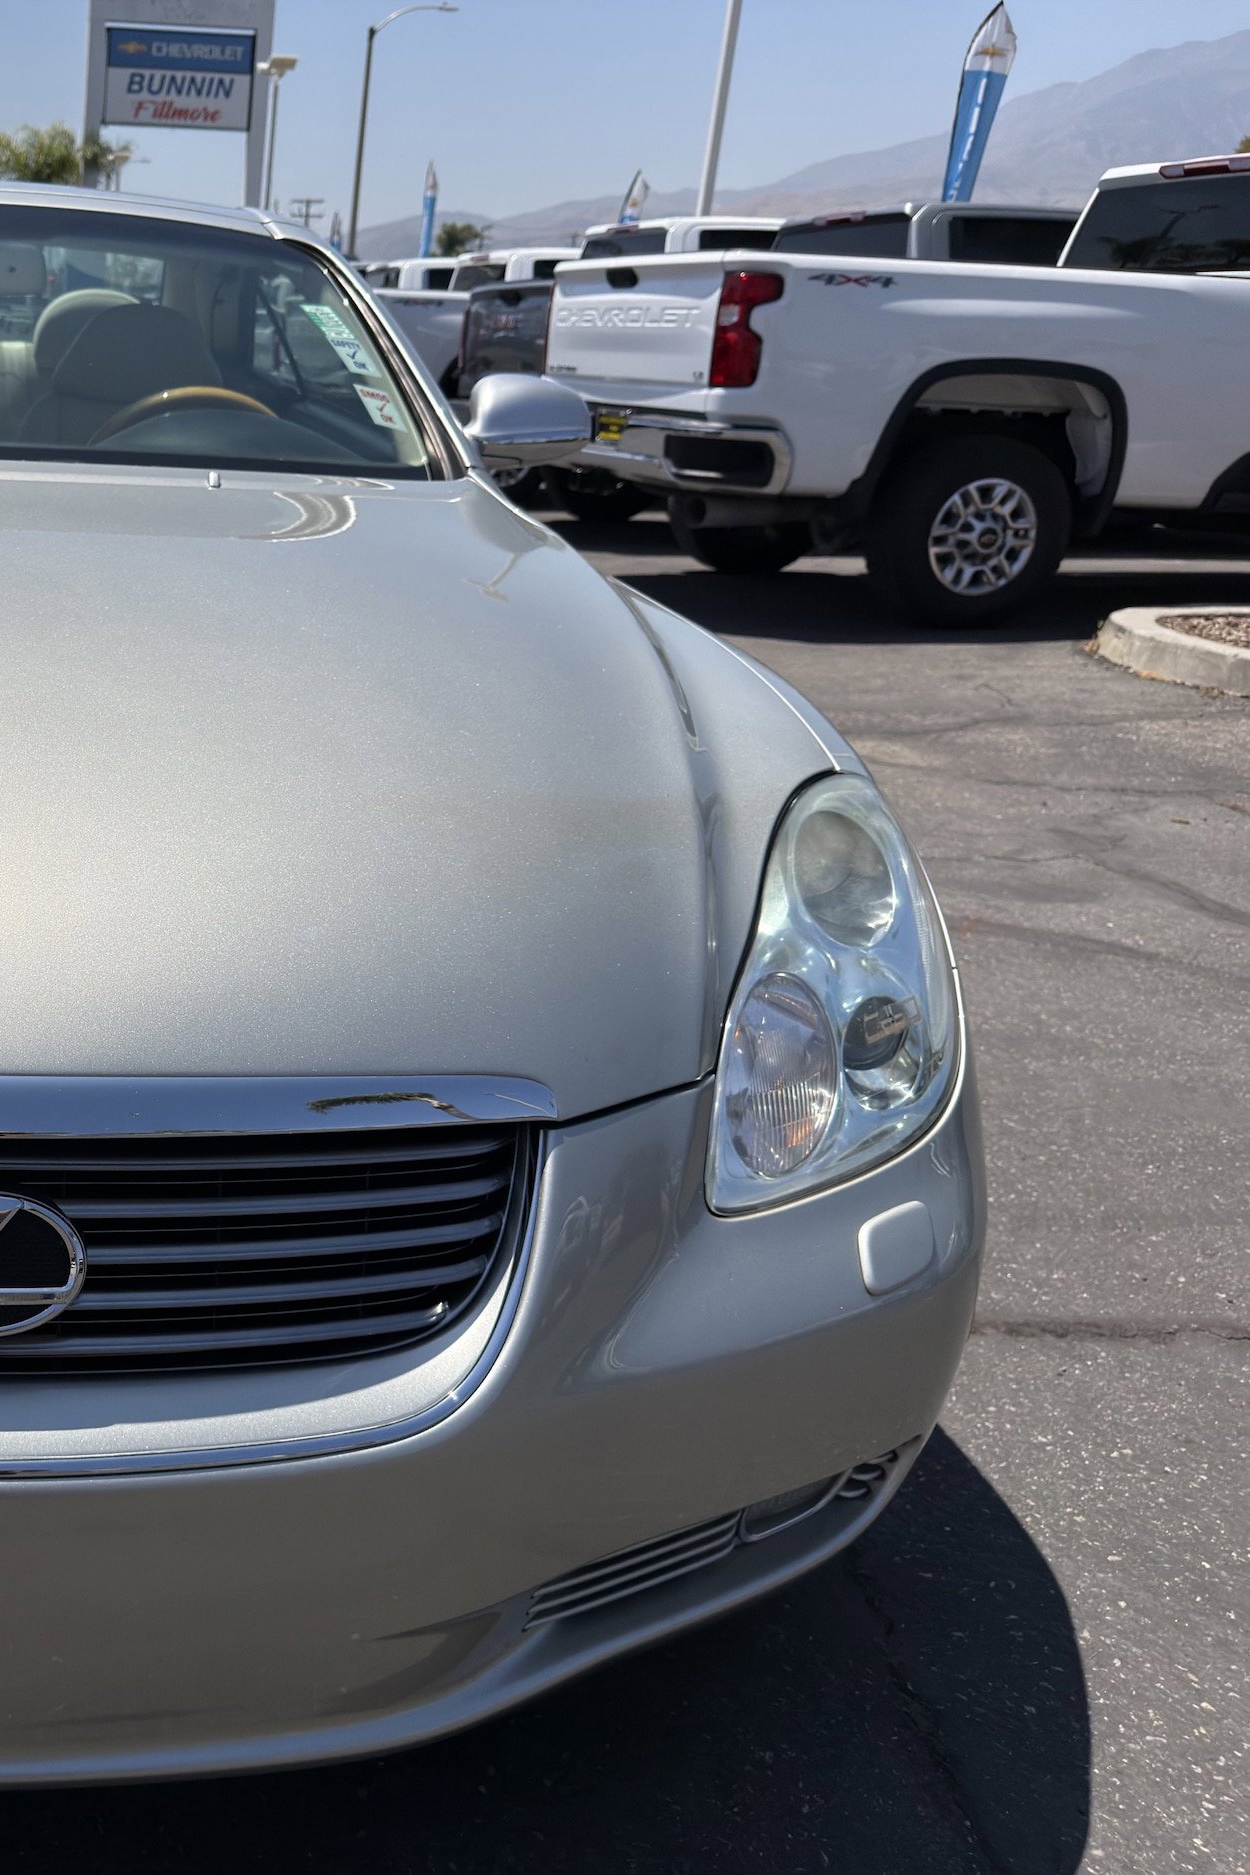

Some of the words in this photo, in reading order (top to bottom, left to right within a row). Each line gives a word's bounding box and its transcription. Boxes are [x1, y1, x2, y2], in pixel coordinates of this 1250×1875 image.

[151, 41, 245, 61] CHEVROLET
[126, 72, 234, 99] BUNNIN
[133, 100, 220, 124] Fillmore
[556, 307, 701, 328] CHEVROLET
